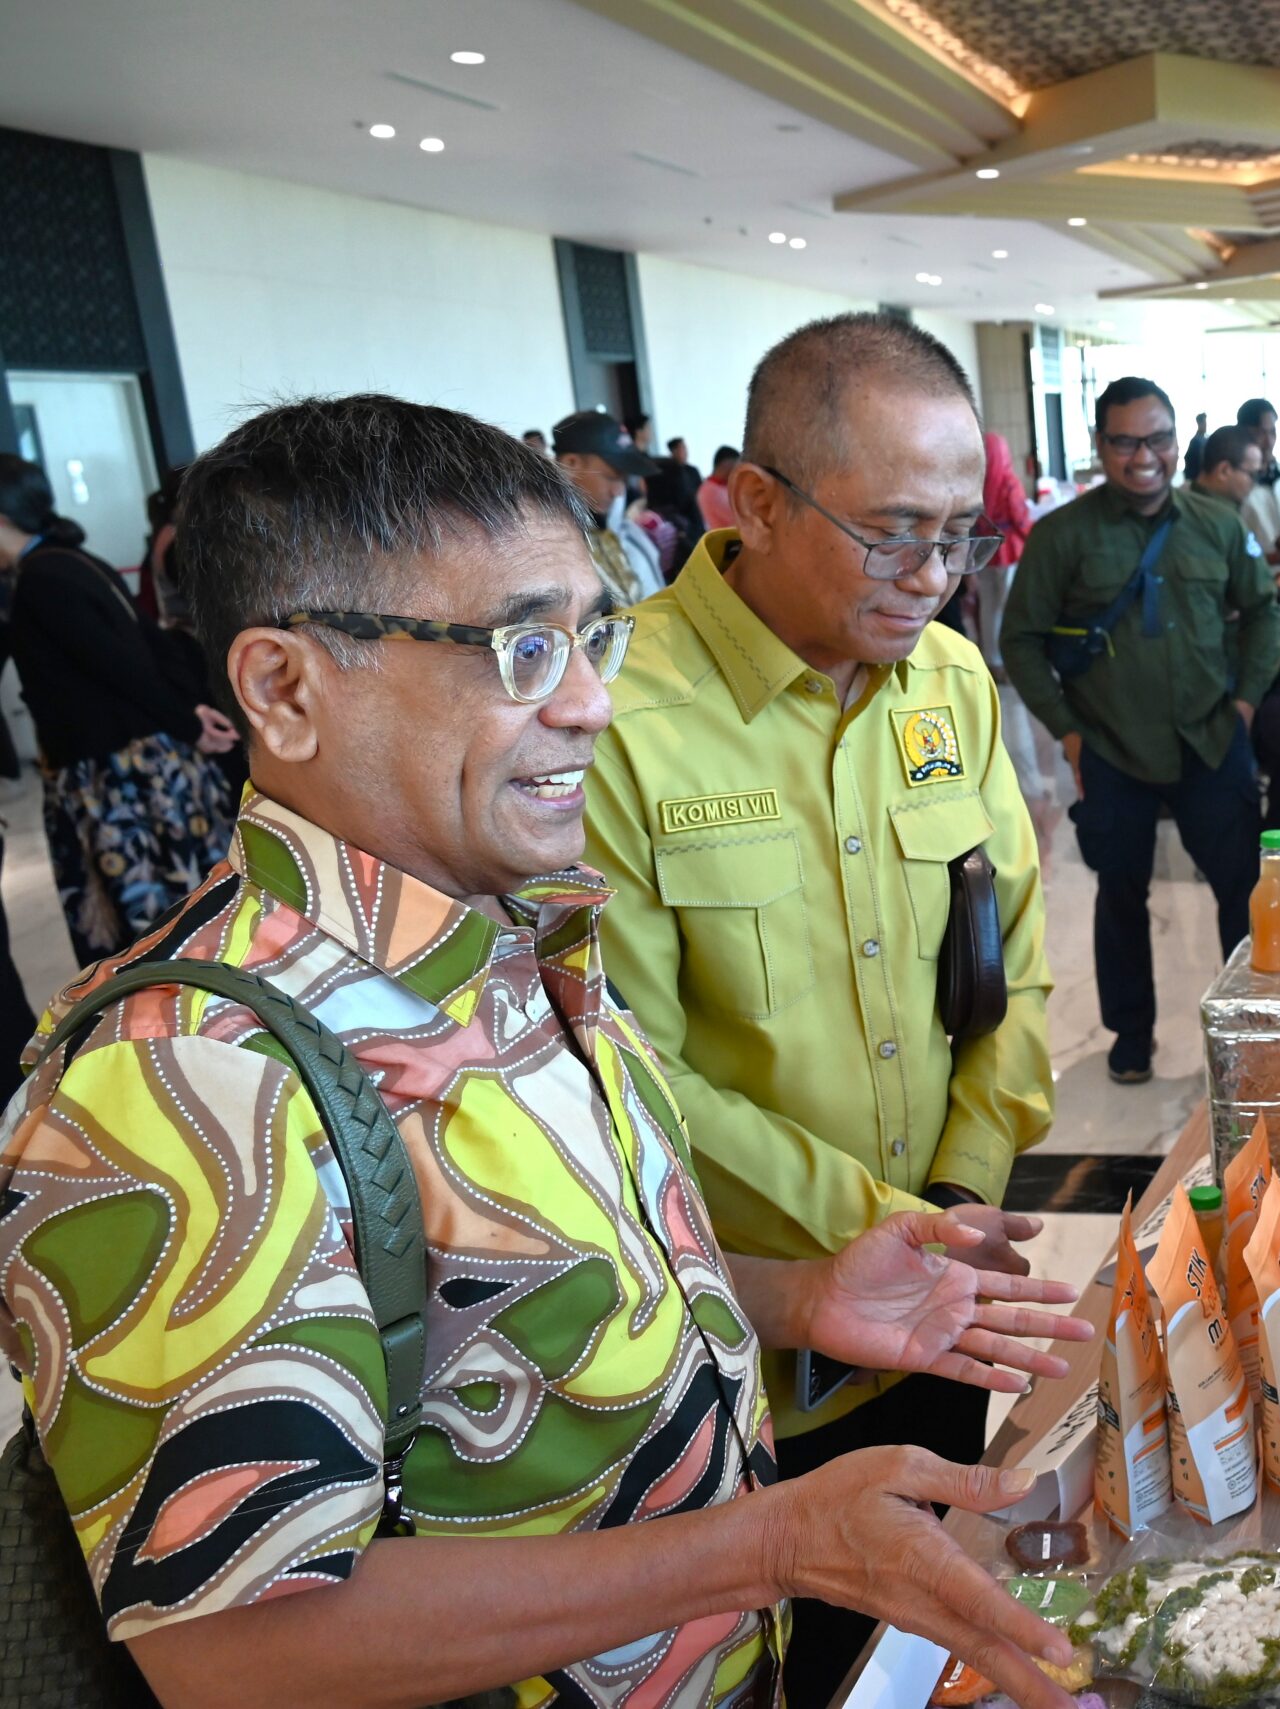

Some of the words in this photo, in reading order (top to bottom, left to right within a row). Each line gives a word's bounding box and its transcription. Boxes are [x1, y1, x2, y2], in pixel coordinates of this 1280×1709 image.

[671, 798, 744, 825] KOMISI
[747, 796, 772, 815] VII
[1187, 1248, 1207, 1297] STIK
